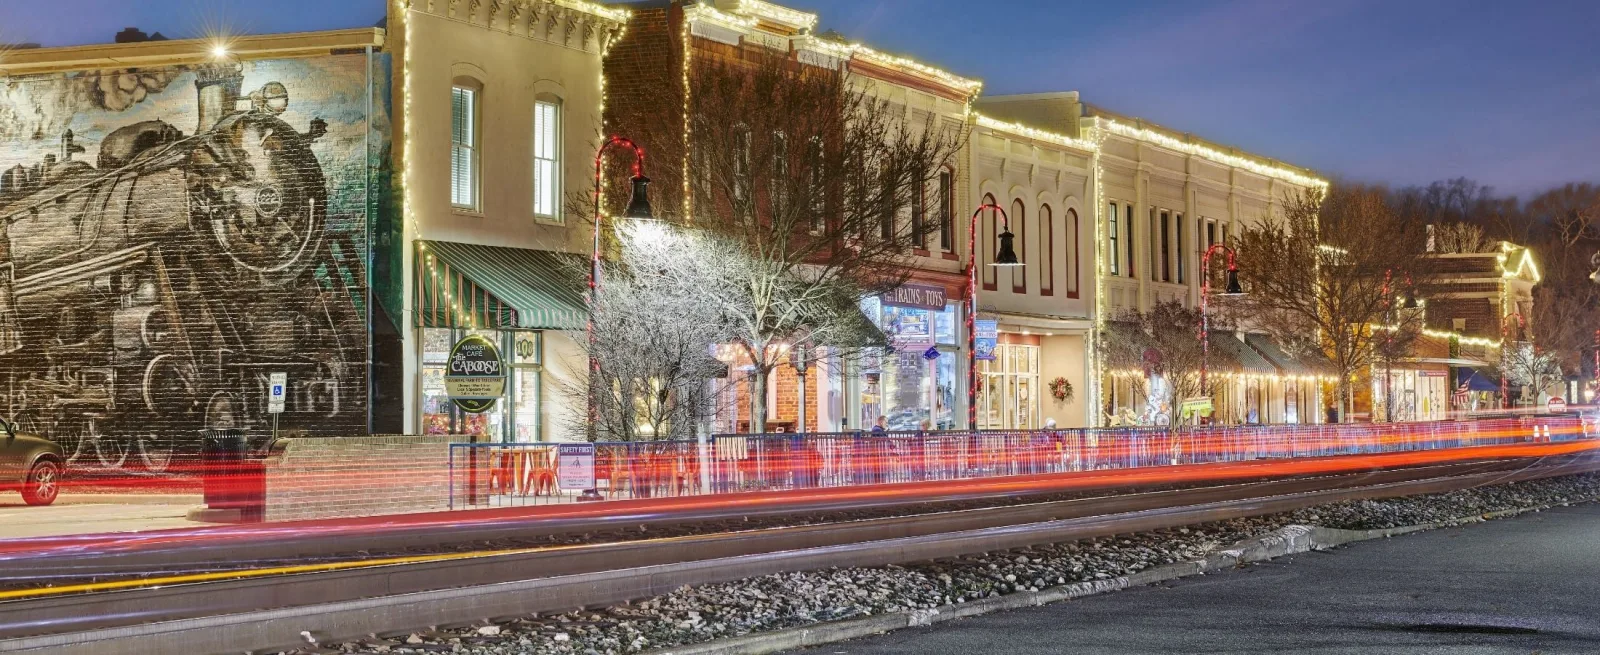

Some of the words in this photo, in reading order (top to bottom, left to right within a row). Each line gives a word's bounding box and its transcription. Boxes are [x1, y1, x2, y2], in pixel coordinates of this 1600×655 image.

[894, 287, 920, 304] TRAINS
[925, 290, 943, 306] TOYS
[452, 353, 466, 364] The
[451, 361, 499, 375] CABOOSE
